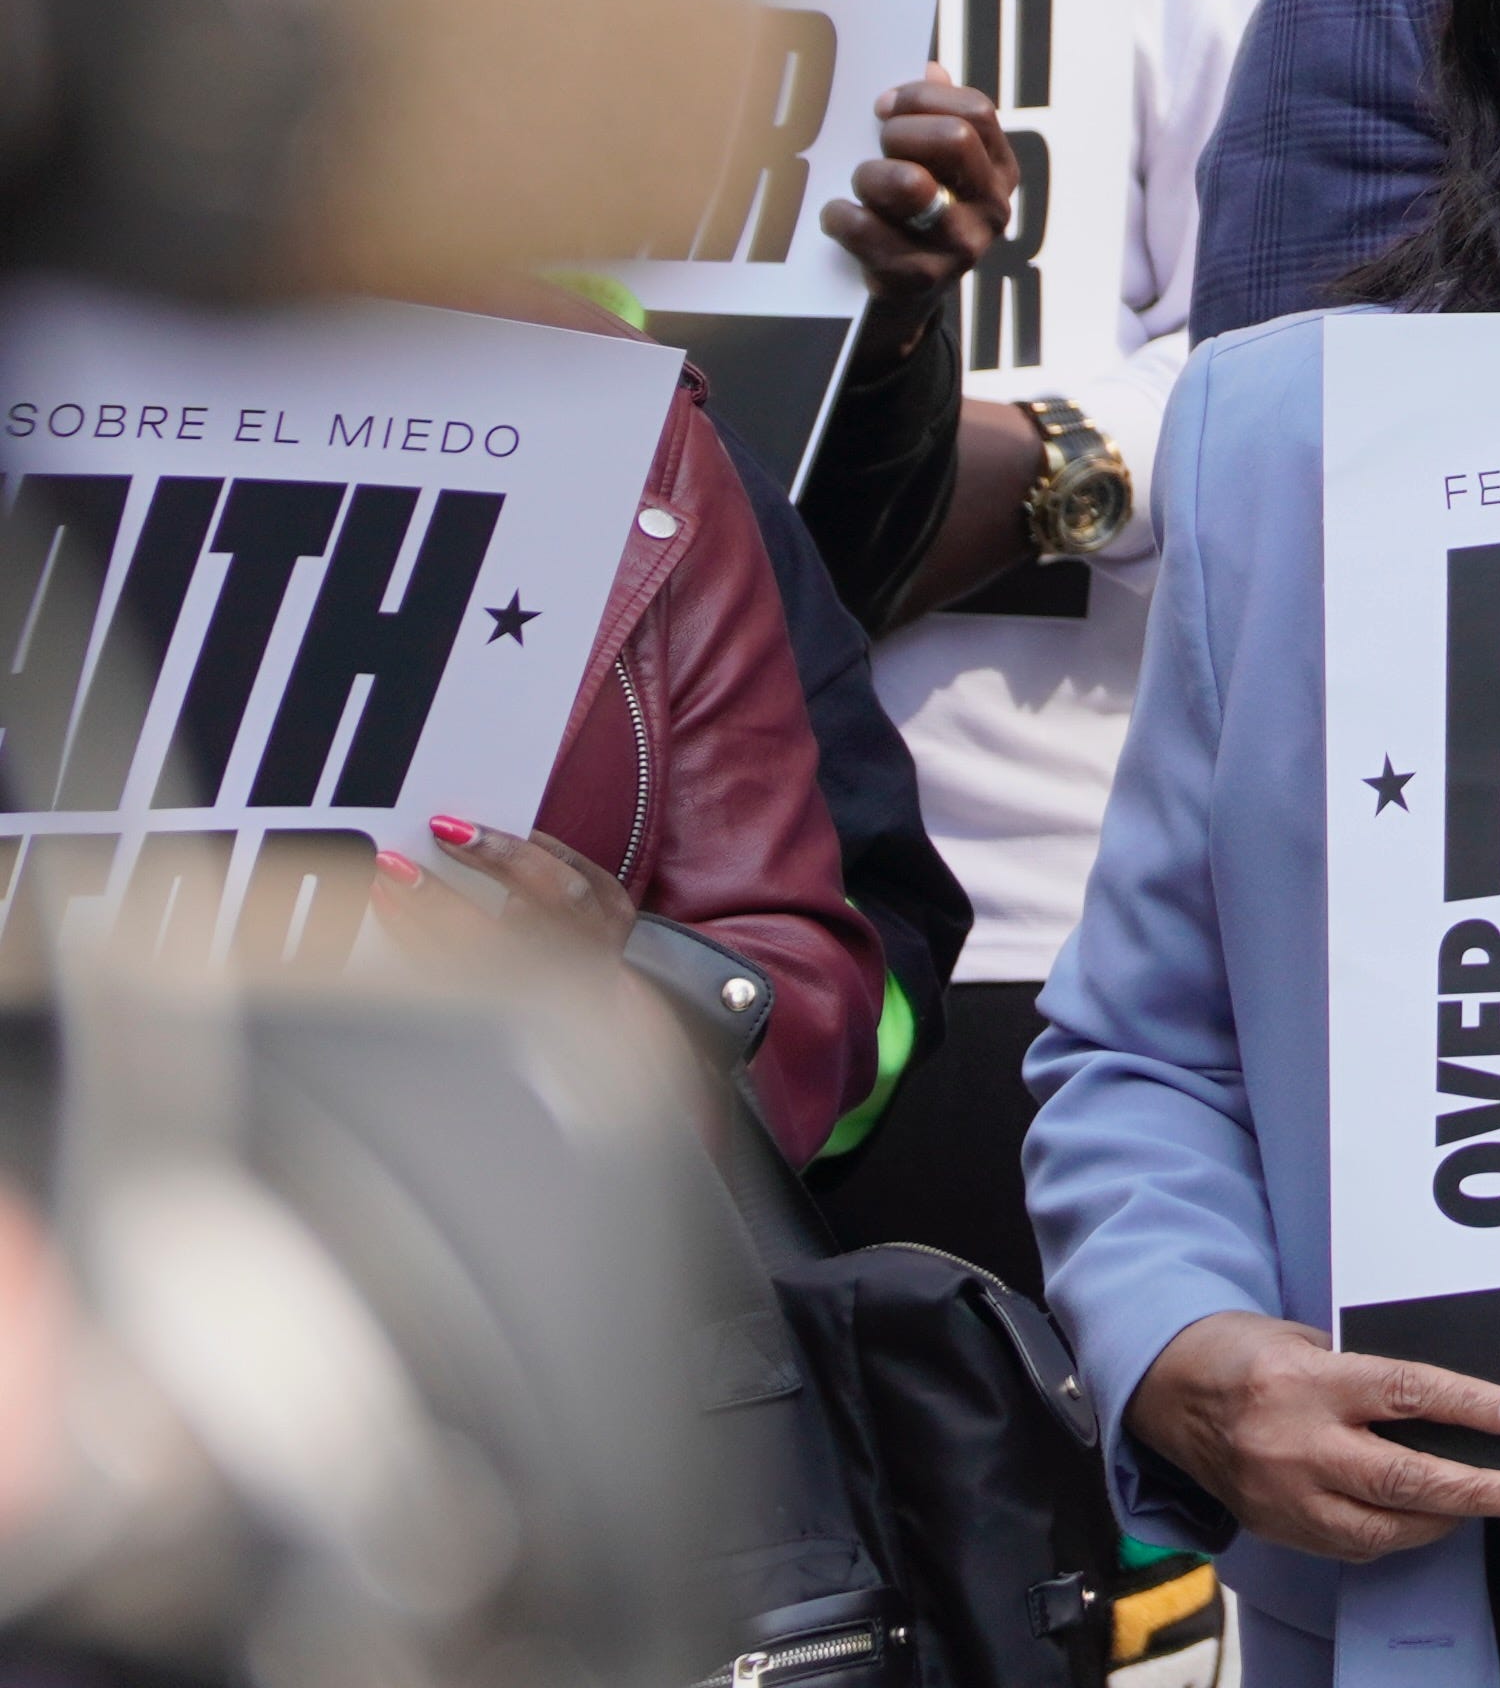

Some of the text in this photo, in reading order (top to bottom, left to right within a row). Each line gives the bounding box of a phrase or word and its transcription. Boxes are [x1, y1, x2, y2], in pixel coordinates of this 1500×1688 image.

[3, 402, 520, 458] SOBRE EL MIEDO
[0, 472, 506, 812] AITH
